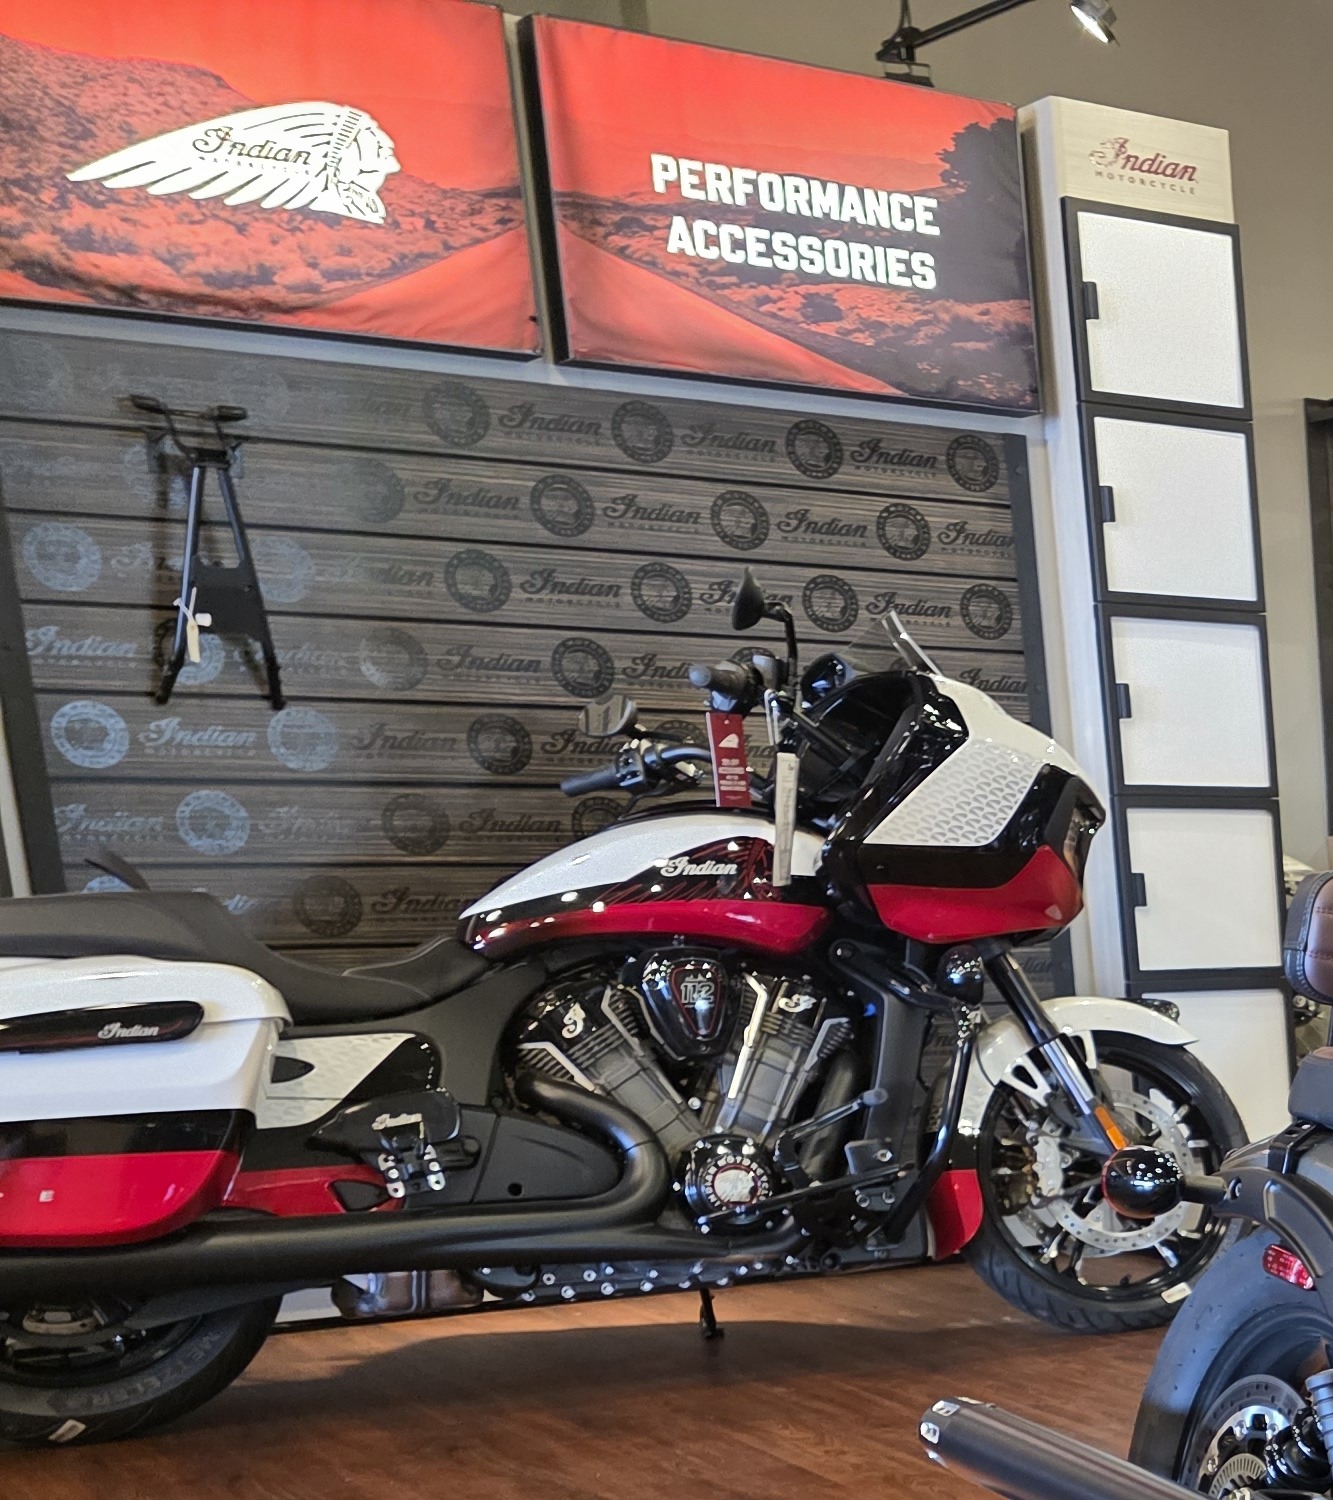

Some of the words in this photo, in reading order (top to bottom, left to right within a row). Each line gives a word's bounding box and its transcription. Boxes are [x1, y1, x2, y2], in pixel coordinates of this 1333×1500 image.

[193, 126, 311, 166] Indian
[1088, 137, 1197, 182] Indian
[651, 153, 940, 236] PERFORMANCE
[1095, 170, 1196, 195] MOTORCYCLE
[666, 216, 937, 290] ACCESSORIES
[851, 438, 938, 468] Indian
[602, 494, 700, 525] Indian
[776, 508, 868, 539] Indian
[938, 521, 1014, 548] India
[520, 568, 622, 597] Indian
[865, 591, 953, 619] Indian
[137, 717, 257, 747] Indian
[660, 855, 738, 878] Indian
[680, 982, 715, 1004] 112
[97, 1021, 160, 1041] Indian
